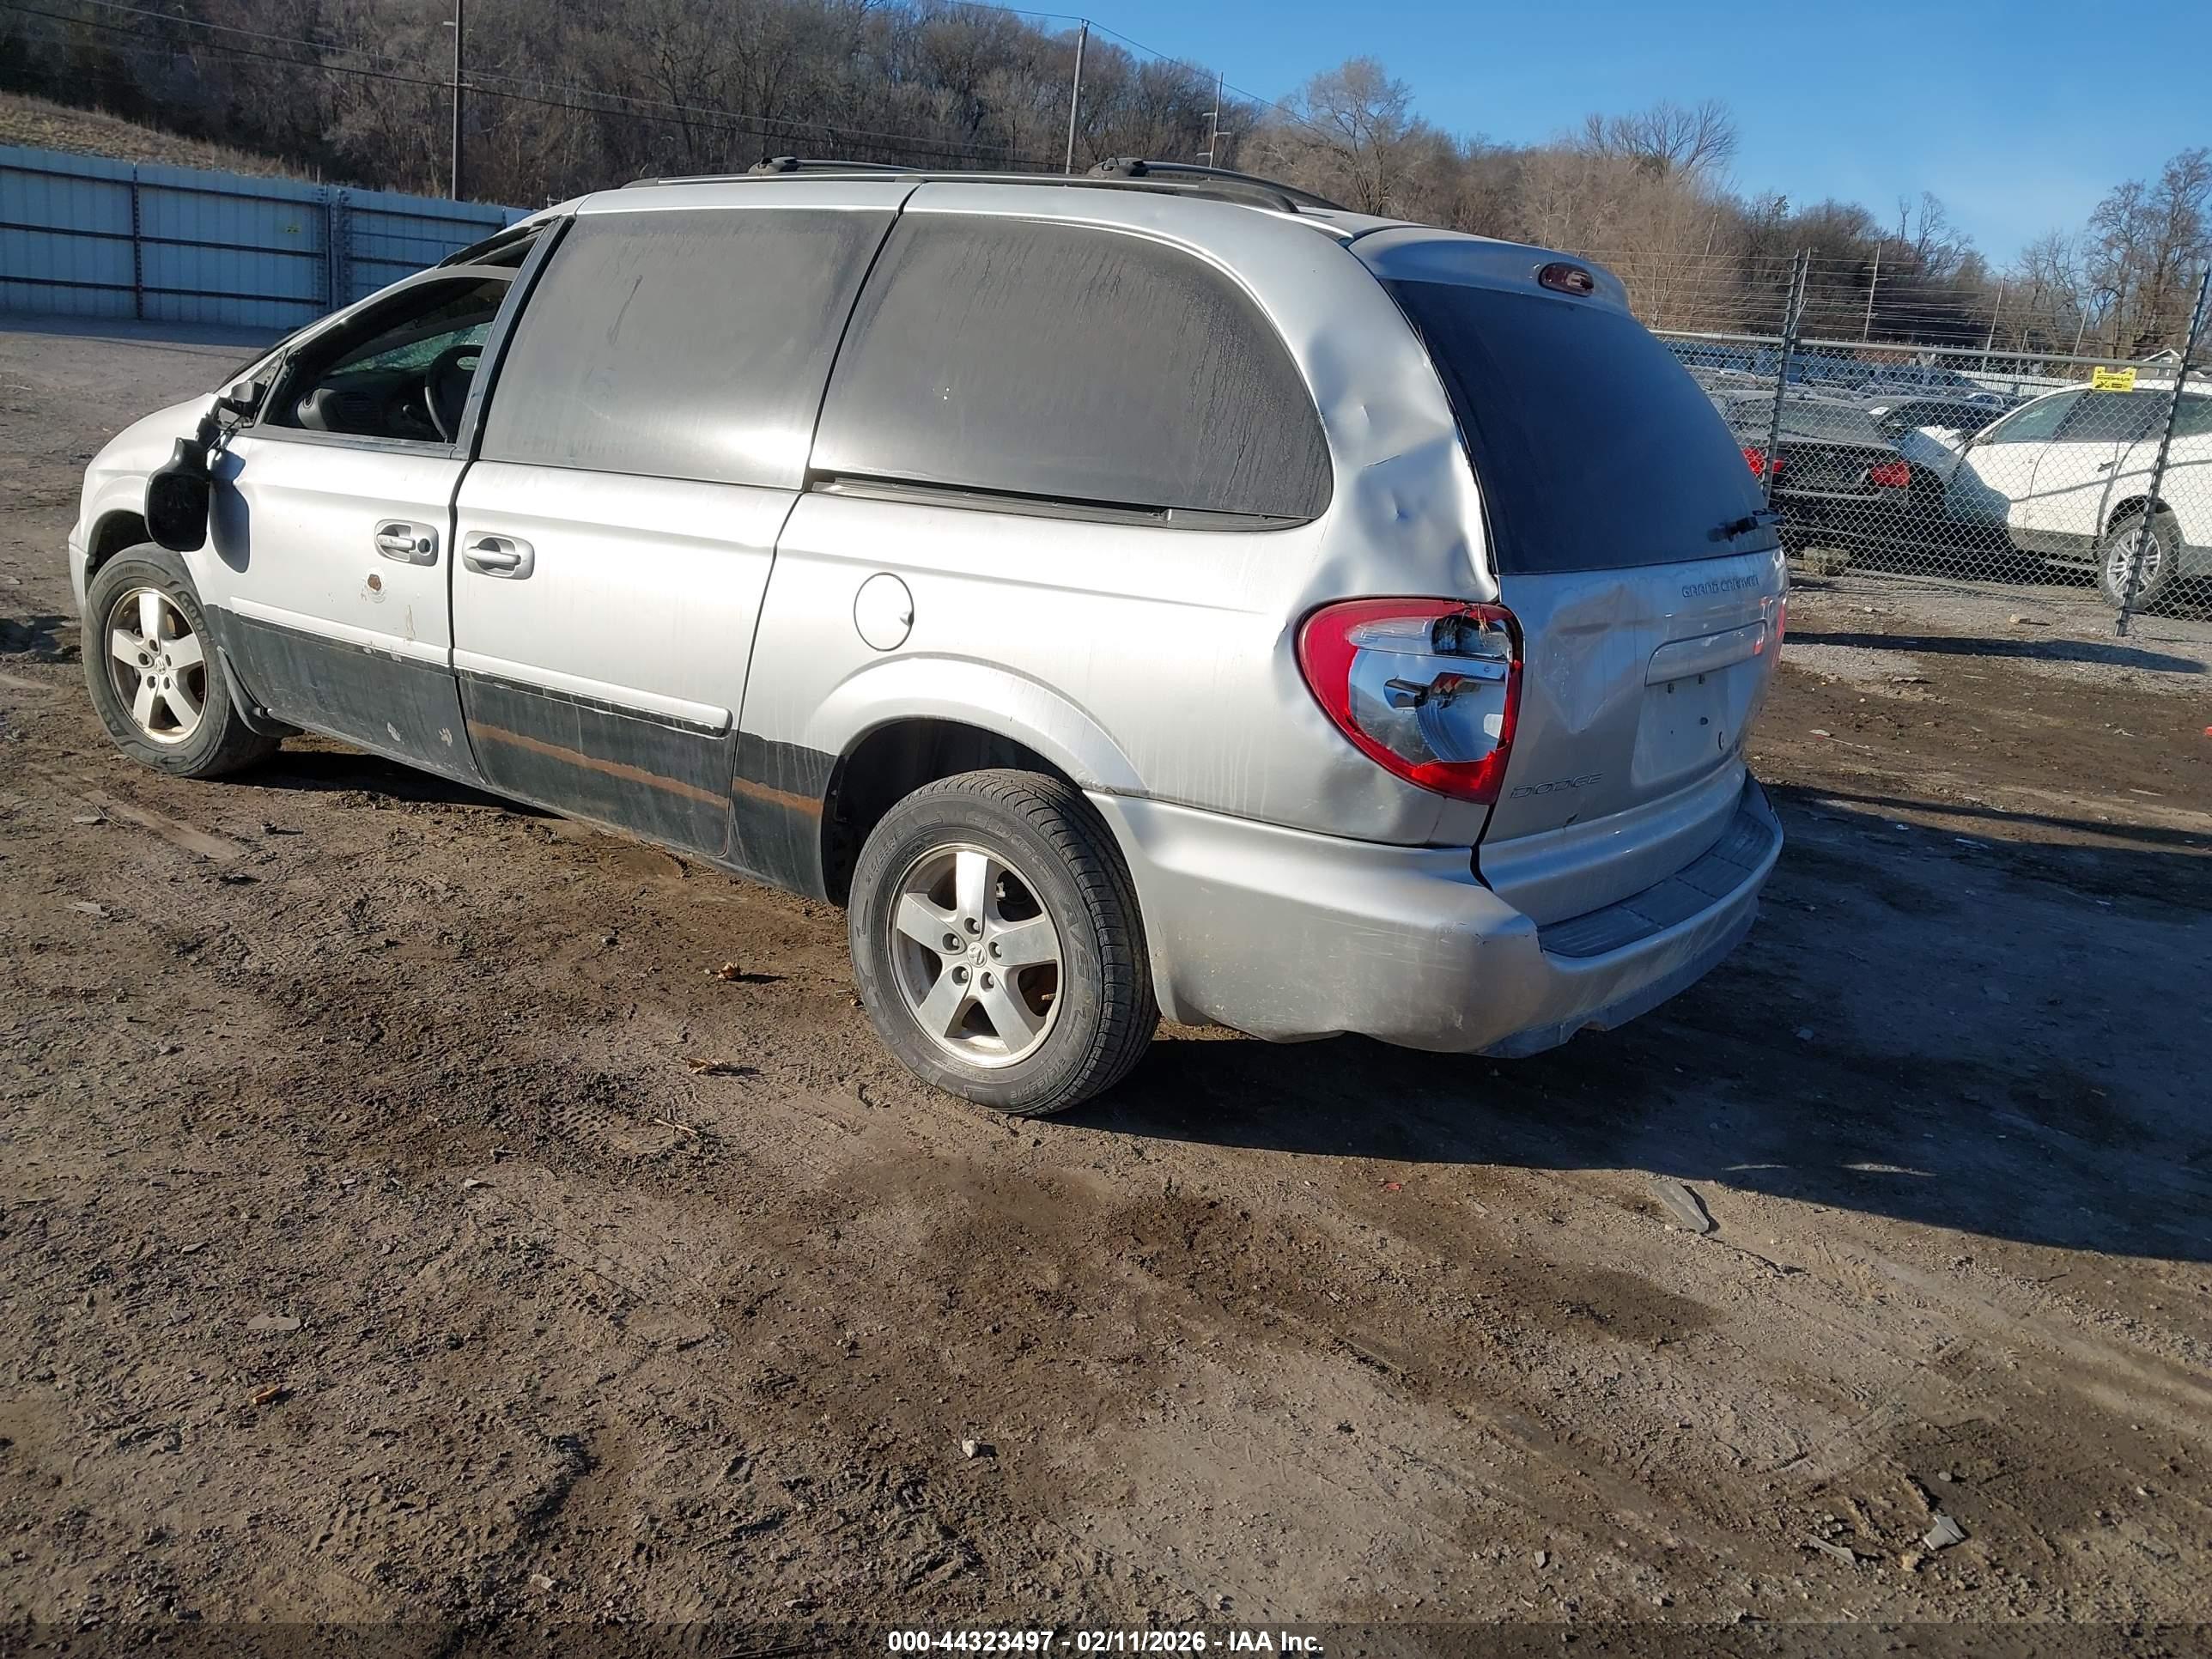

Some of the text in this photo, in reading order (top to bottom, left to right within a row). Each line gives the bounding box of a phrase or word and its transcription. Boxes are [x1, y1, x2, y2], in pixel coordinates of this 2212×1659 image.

[1681, 574, 1759, 598] GRAND CARAVAN
[1510, 772, 1604, 799] DODGE
